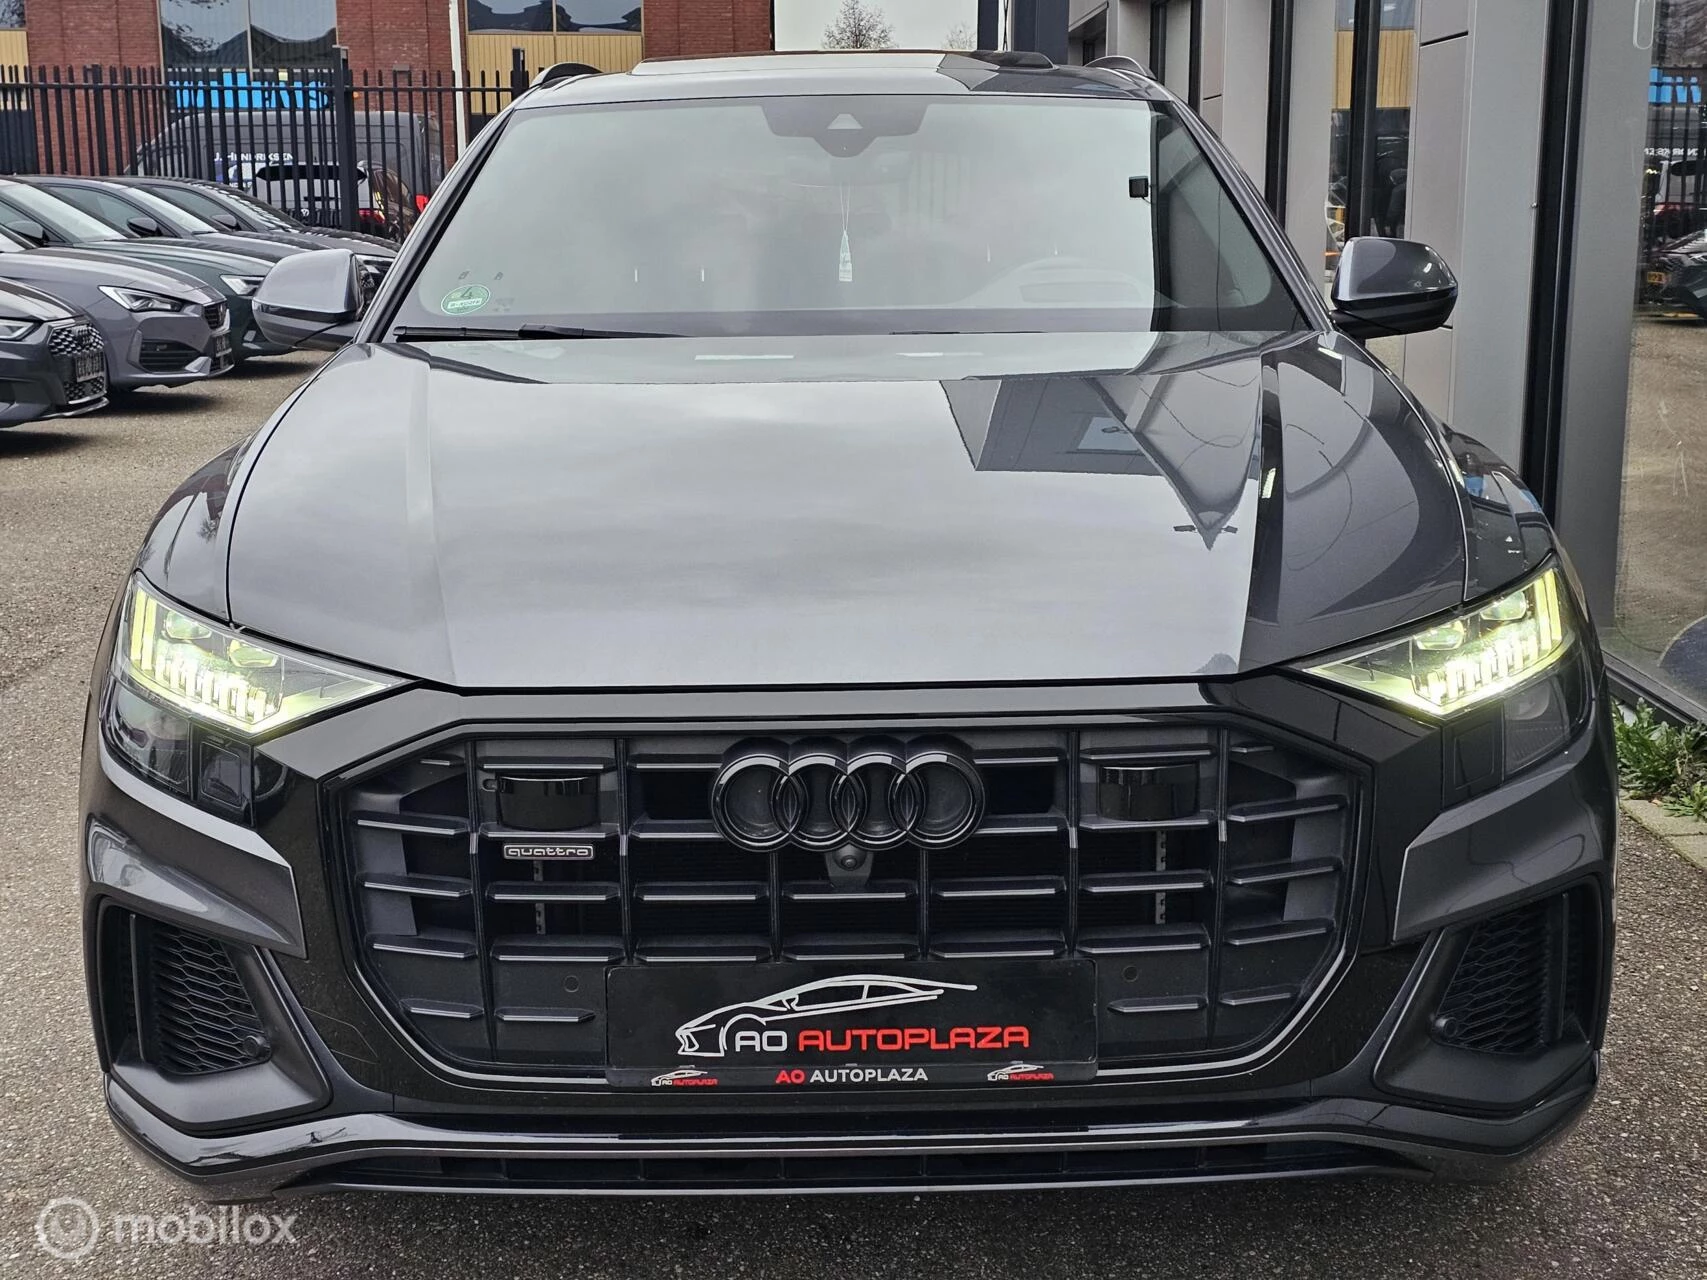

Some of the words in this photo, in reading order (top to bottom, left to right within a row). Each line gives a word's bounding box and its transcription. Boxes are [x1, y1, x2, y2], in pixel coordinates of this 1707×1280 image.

[460, 286, 473, 300] 4
[508, 847, 589, 857] quattro
[735, 1030, 788, 1052] AO
[799, 1026, 1030, 1051] AUTOPLAZA
[776, 1069, 806, 1084] AO
[810, 1068, 929, 1082] AUTOPLAZA
